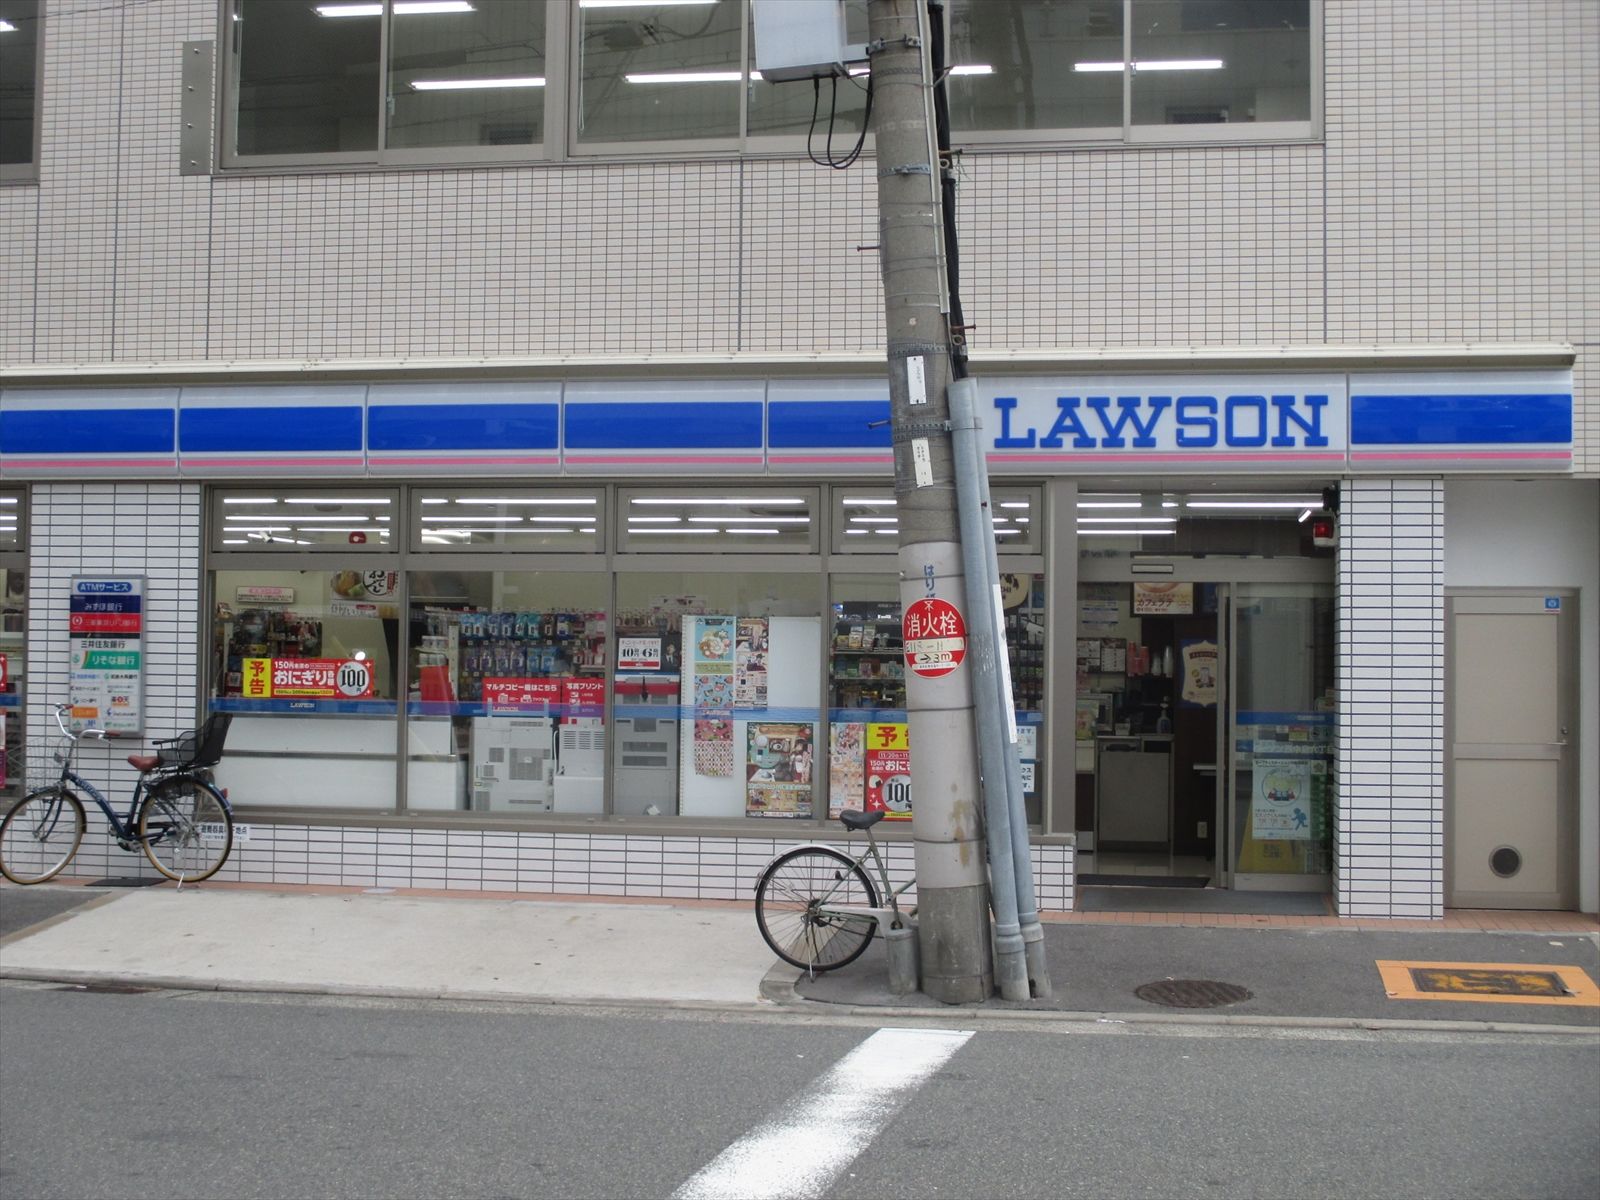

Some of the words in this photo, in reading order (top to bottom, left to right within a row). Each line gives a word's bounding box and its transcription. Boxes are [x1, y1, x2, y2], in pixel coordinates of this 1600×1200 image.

[994, 395, 1329, 449] LAWSON
[80, 583, 129, 592] ATMサービス
[84, 602, 123, 612] みずほ銀行
[907, 610, 958, 638] 消火栓
[81, 640, 126, 649] 三井住友銀行
[92, 655, 135, 665] りそな銀行
[249, 660, 265, 695] 予告
[274, 669, 327, 686] おにぎり
[340, 669, 366, 688] 100
[486, 683, 558, 692] マルチコピー機はこちら
[566, 682, 604, 690] 写真プリント
